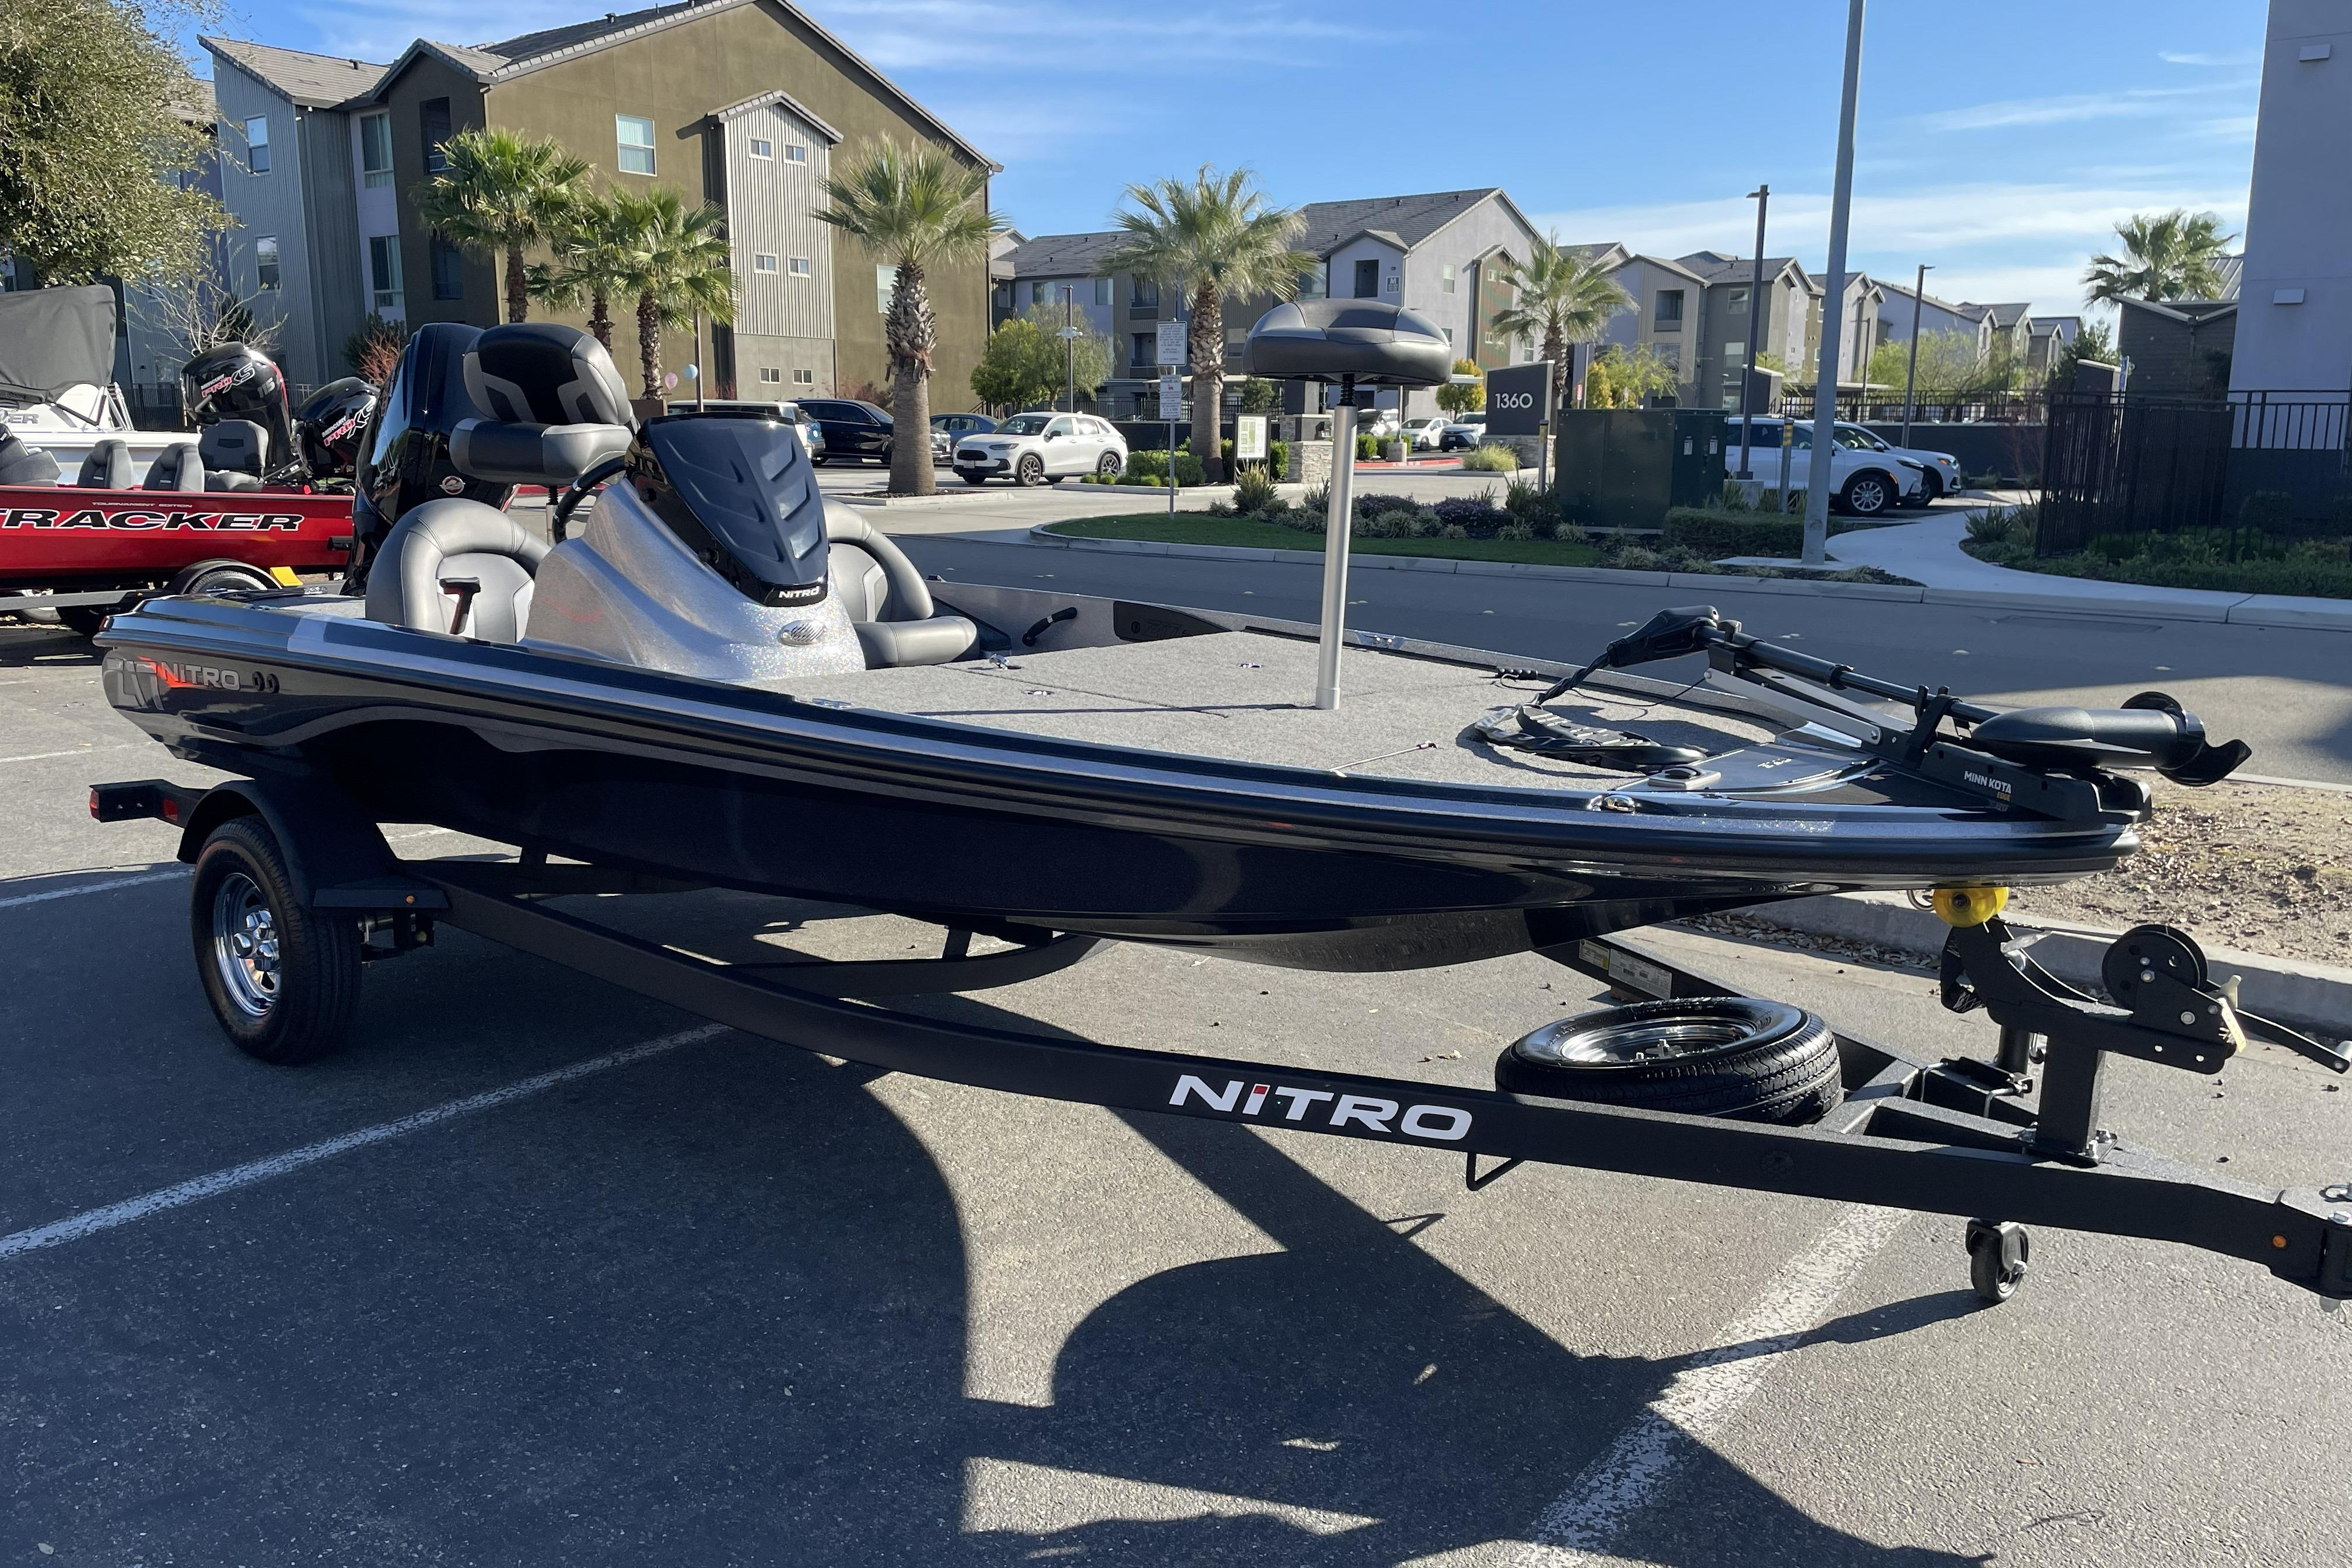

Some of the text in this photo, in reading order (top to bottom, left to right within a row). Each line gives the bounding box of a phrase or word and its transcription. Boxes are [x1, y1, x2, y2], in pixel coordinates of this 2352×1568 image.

[257, 377, 275, 398] 115
[1495, 393, 1533, 408] 1360
[1964, 771, 2011, 794] MINN KOTA
[1997, 792, 2011, 802] EDGE
